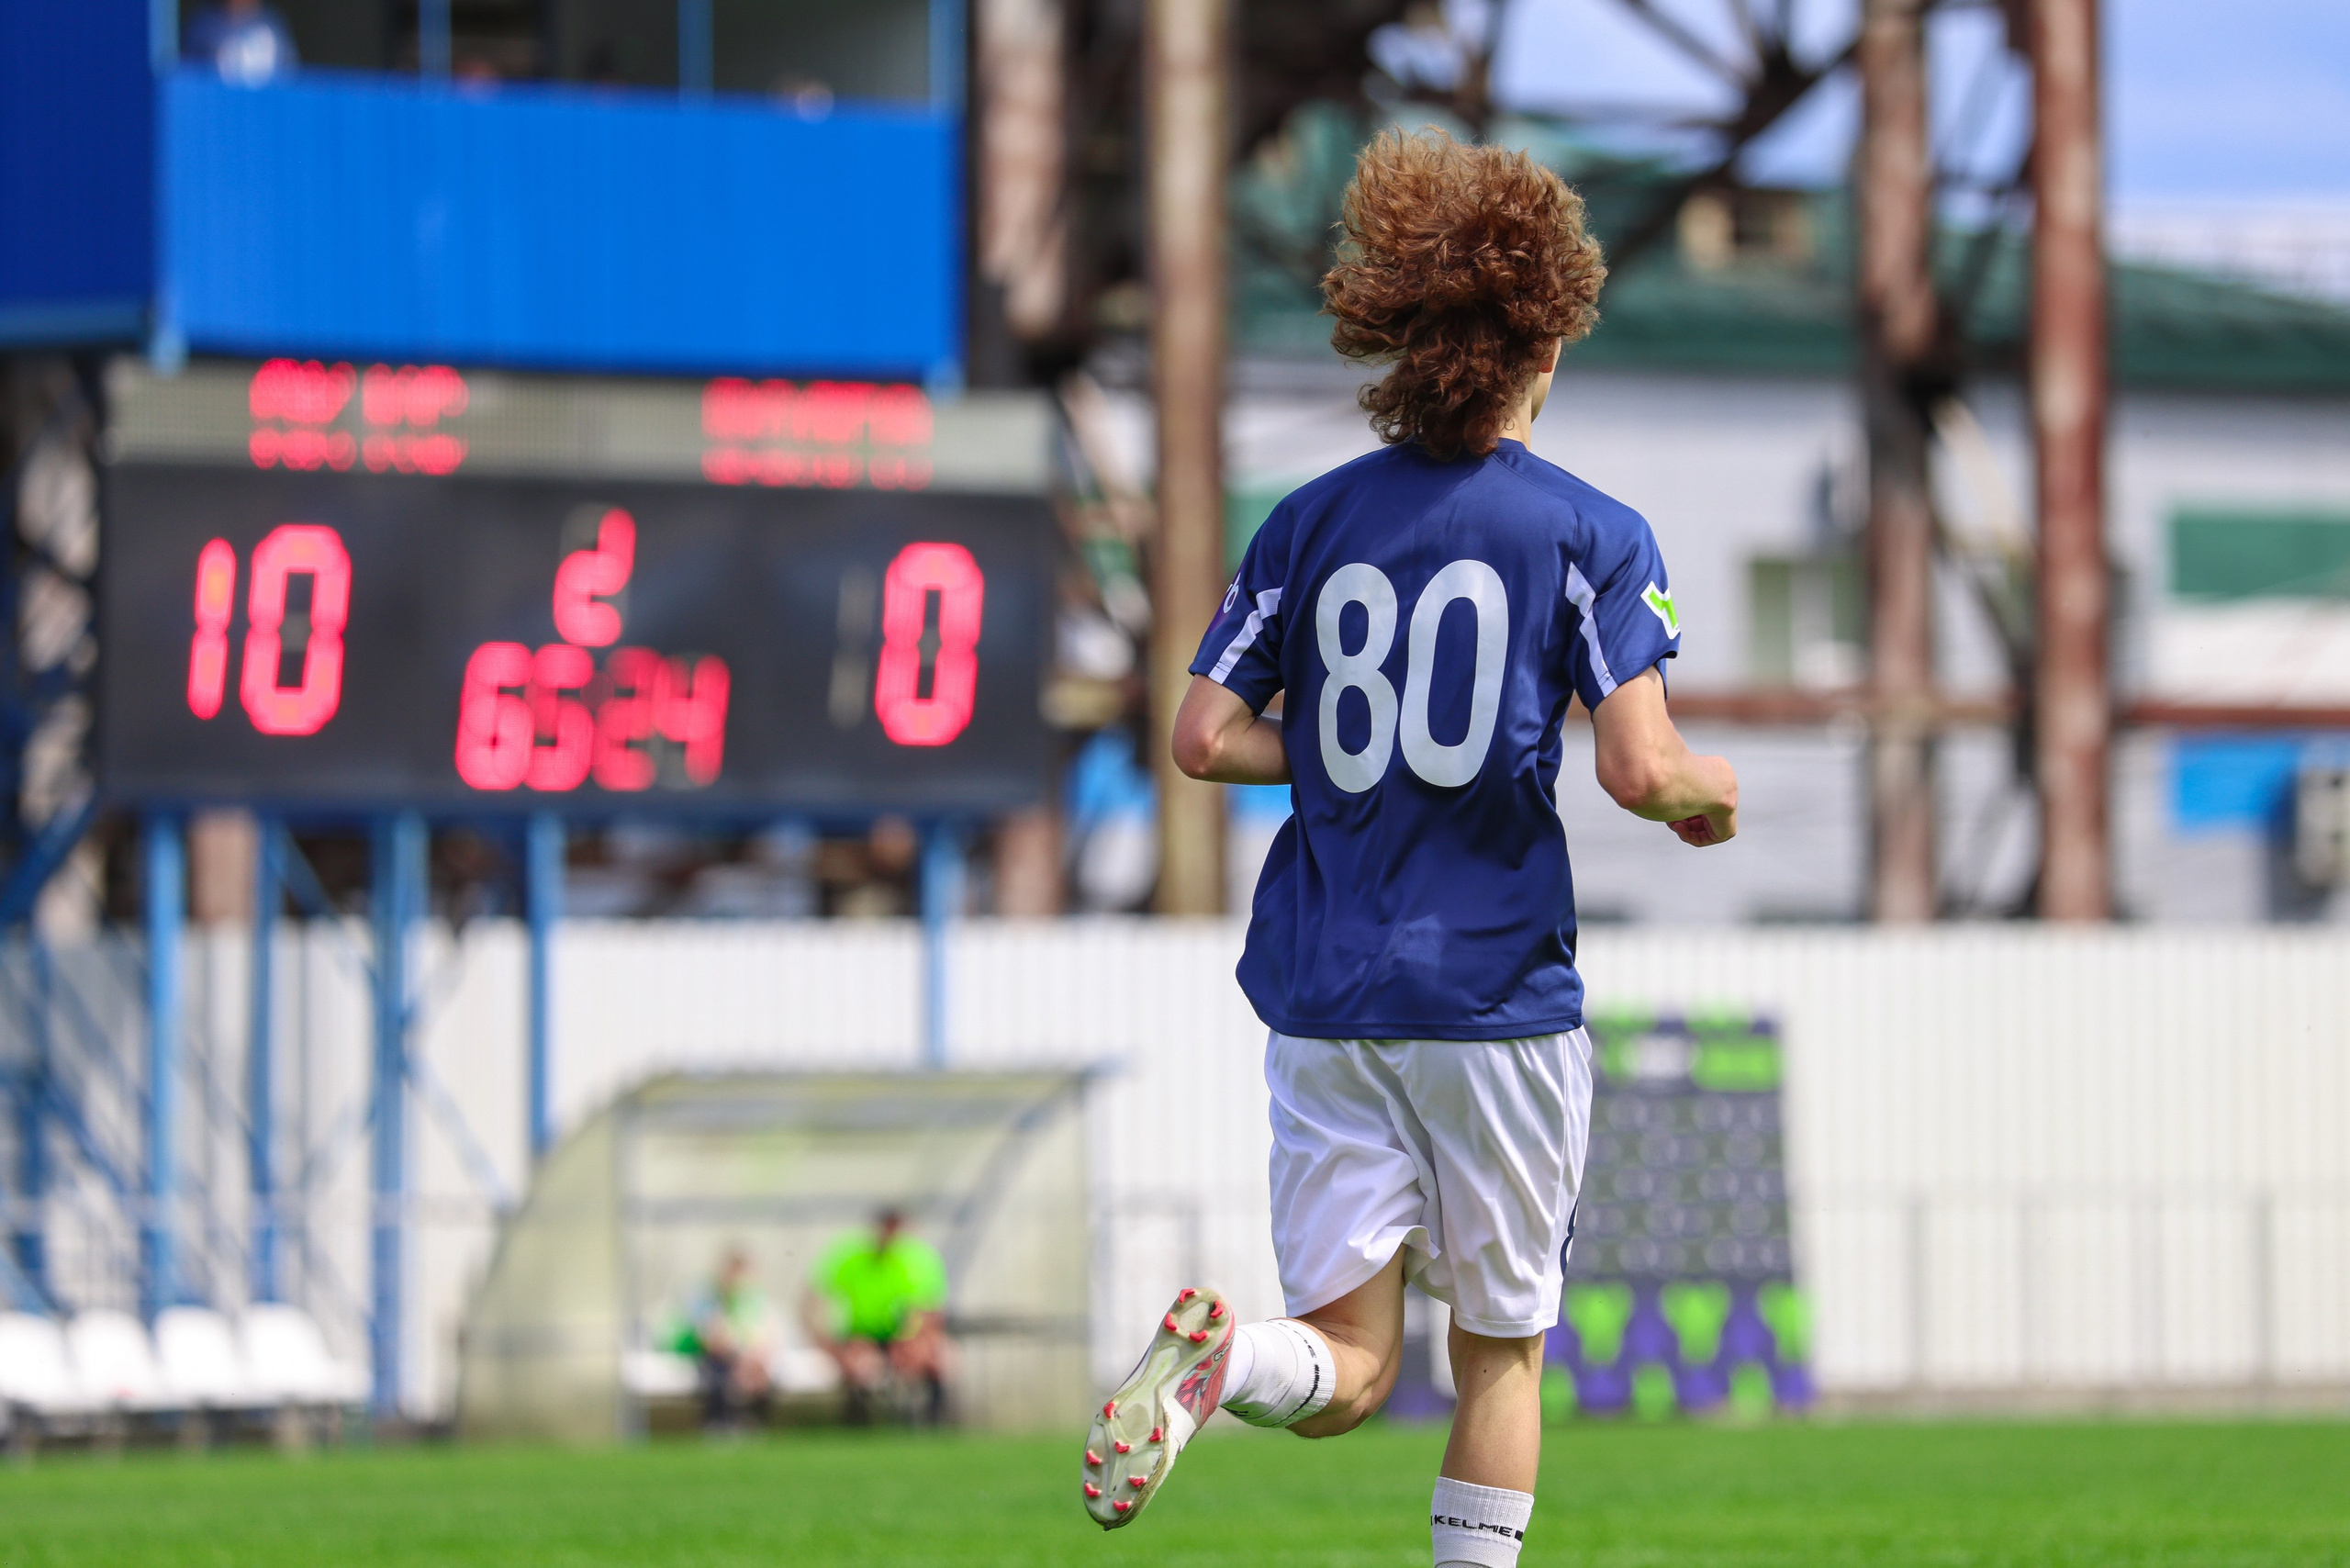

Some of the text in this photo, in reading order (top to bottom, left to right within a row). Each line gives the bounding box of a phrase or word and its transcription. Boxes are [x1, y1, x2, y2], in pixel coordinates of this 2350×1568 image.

[186, 523, 352, 736] 10
[875, 542, 984, 746] 0
[1316, 559, 1508, 793] 80
[1435, 1515, 1513, 1538] KELME
